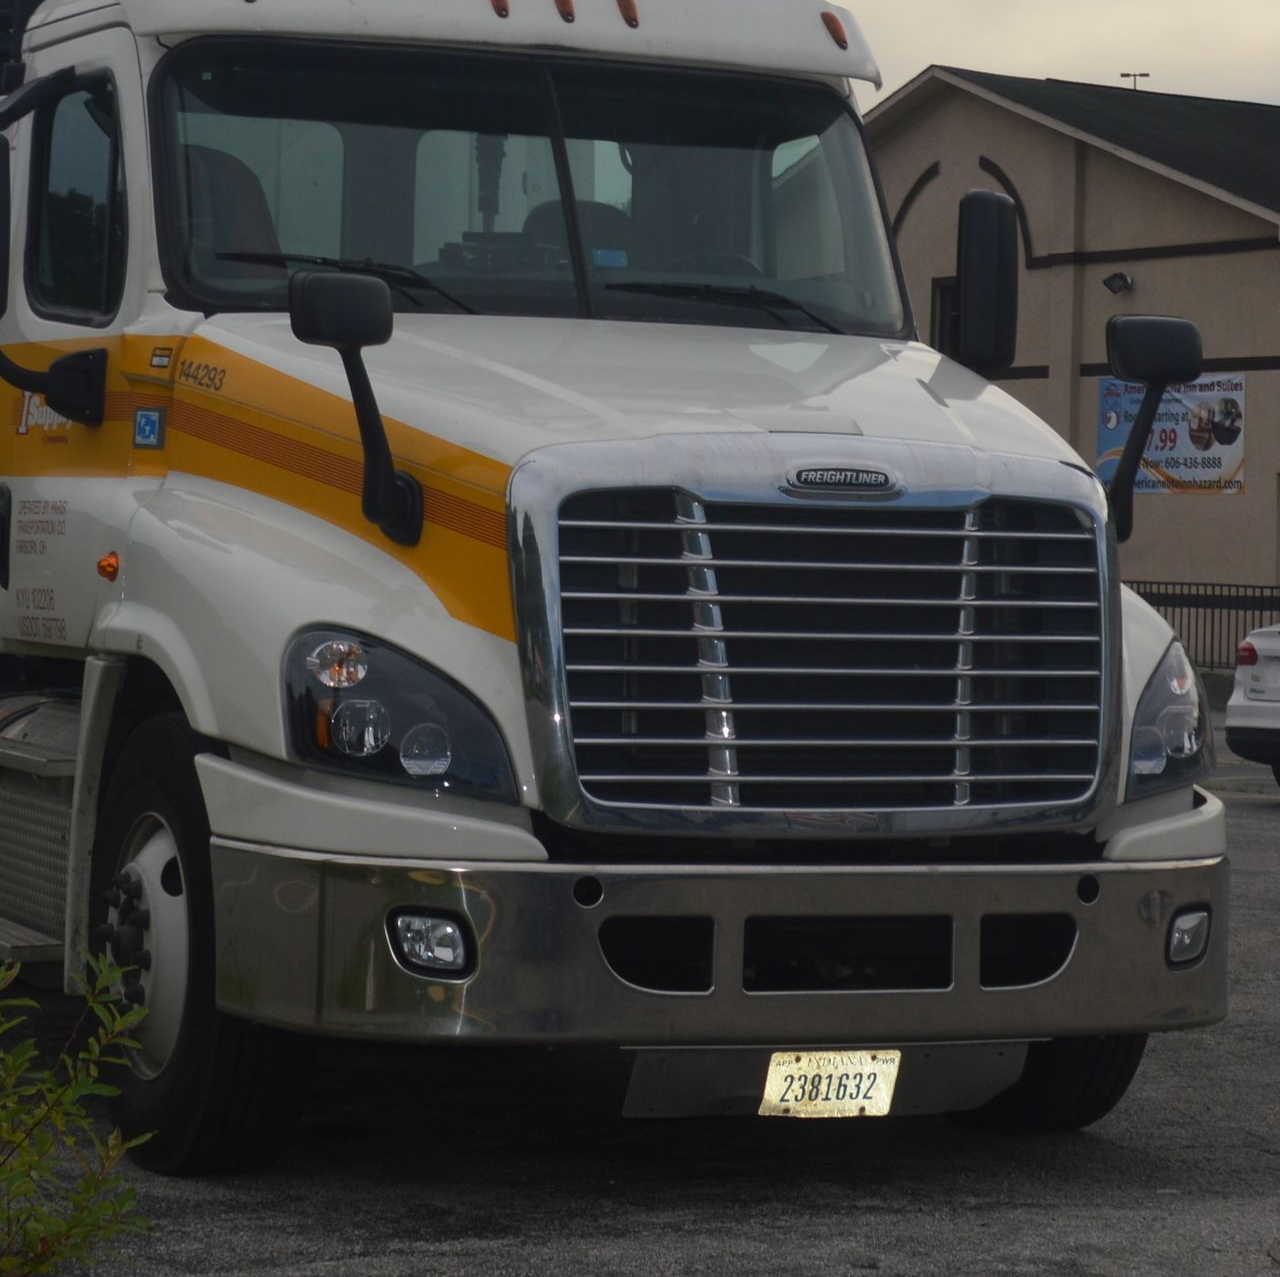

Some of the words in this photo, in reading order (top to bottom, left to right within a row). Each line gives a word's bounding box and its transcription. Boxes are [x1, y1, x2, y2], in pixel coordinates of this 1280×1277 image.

[178, 359, 226, 391] 144293
[1199, 383, 1214, 393] and
[1217, 380, 1243, 392] Suites
[1181, 412, 1189, 422] at
[1165, 456, 1223, 469] 606-436-8888
[800, 470, 885, 485] FREIGHTLINER
[875, 1057, 896, 1066] PWR
[779, 1072, 878, 1104] 2381632
